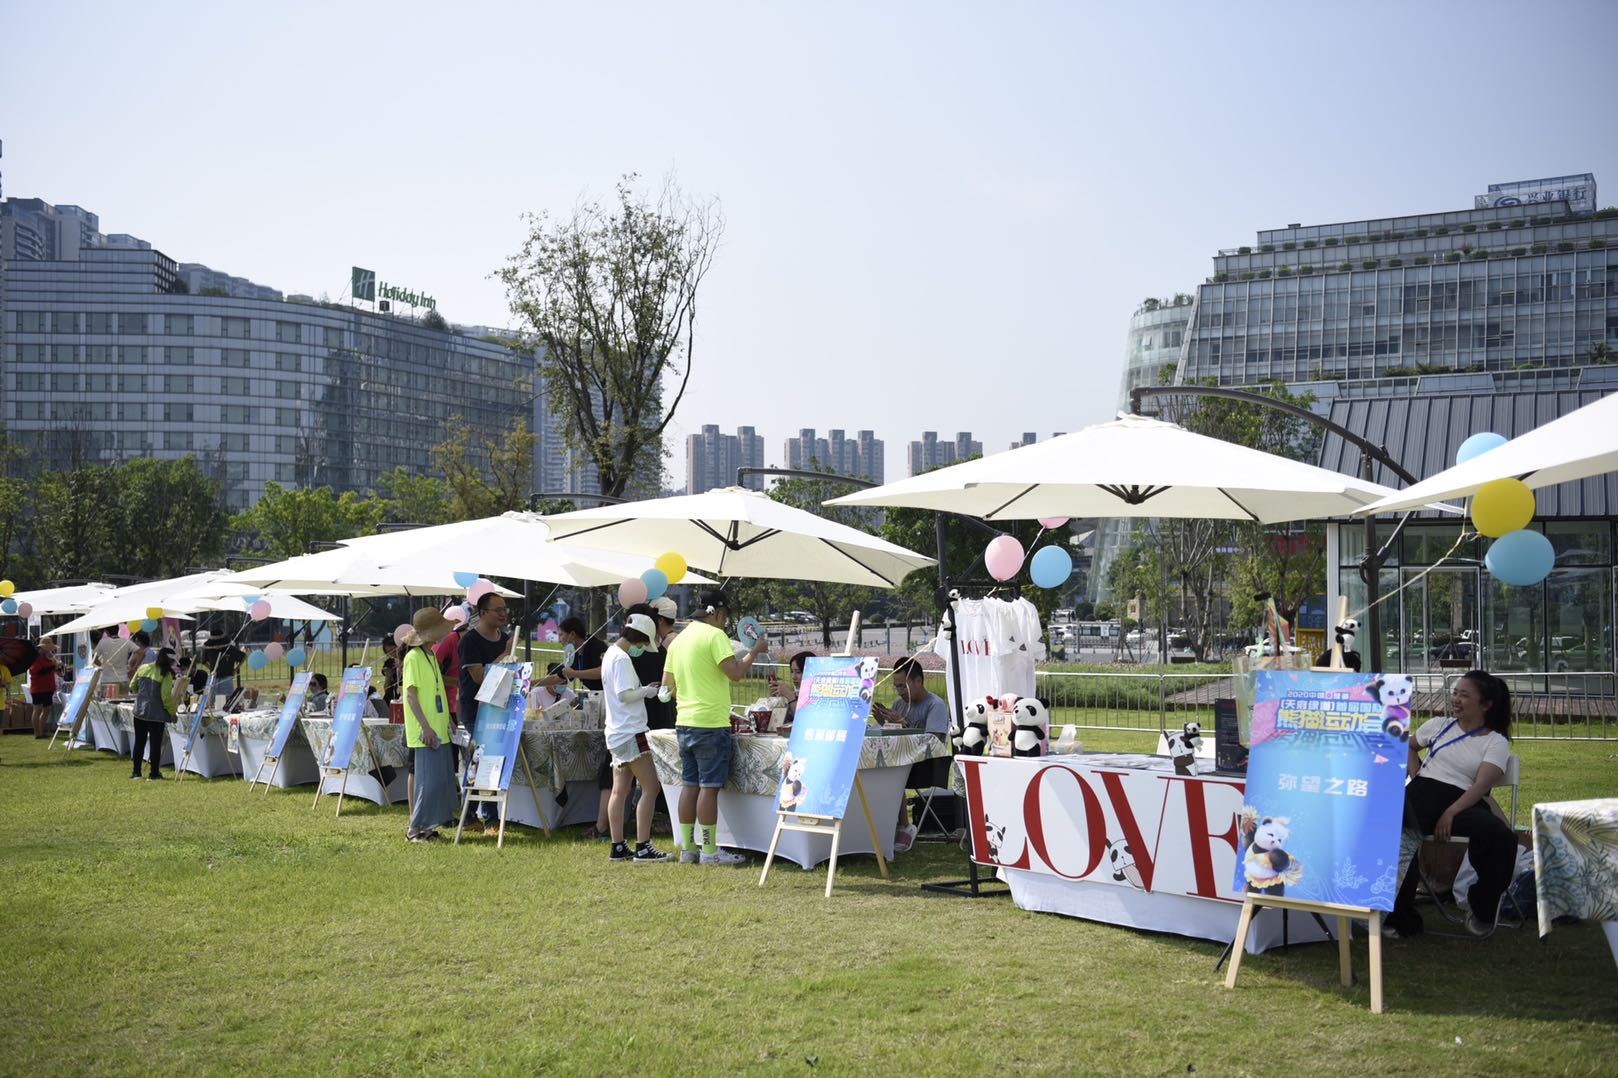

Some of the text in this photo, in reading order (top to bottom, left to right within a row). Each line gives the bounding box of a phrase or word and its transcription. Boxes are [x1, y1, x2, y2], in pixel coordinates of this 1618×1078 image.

[1527, 186, 1587, 204] 兴业银行
[378, 281, 437, 309] Holiday Inn
[1278, 710, 1383, 733] 熊猫运动会
[1278, 774, 1369, 797] 弥望之路
[957, 758, 1246, 904] LOVE
